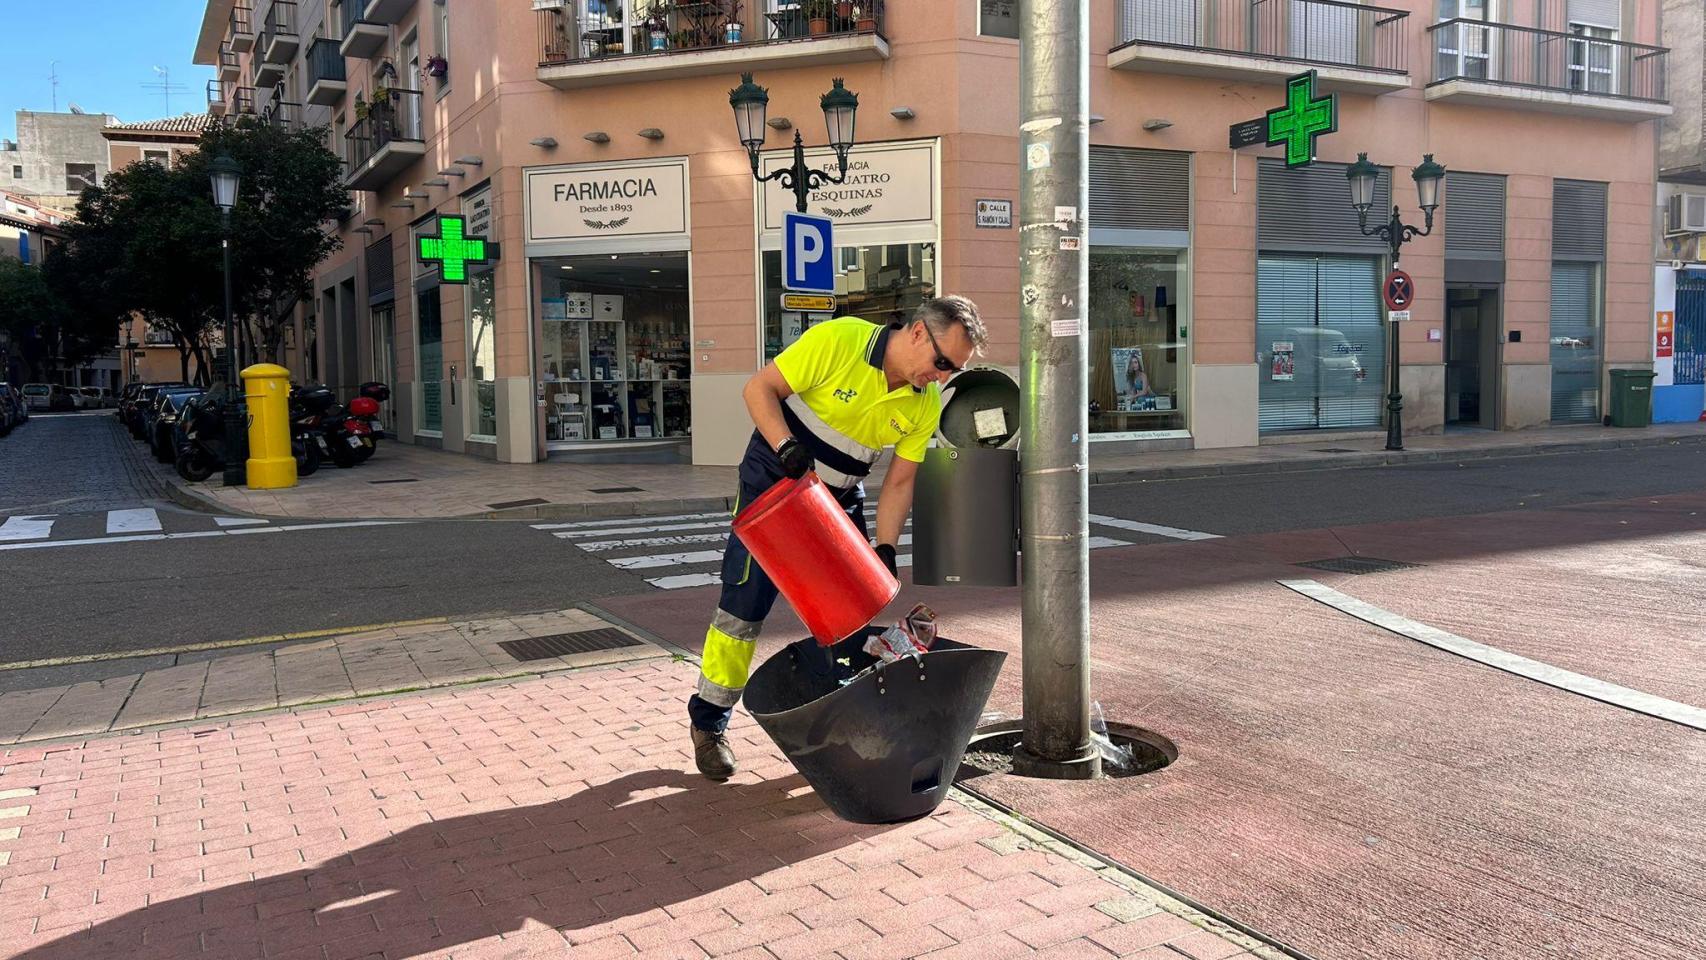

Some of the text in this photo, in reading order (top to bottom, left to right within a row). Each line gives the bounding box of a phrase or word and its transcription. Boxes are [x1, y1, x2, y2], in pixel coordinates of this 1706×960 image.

[823, 161, 870, 172] FARACIA
[554, 178, 657, 202] FARMACIA
[811, 188, 883, 202] ESQUINAS
[579, 203, 633, 213] Desde 1893
[795, 222, 824, 281] P
